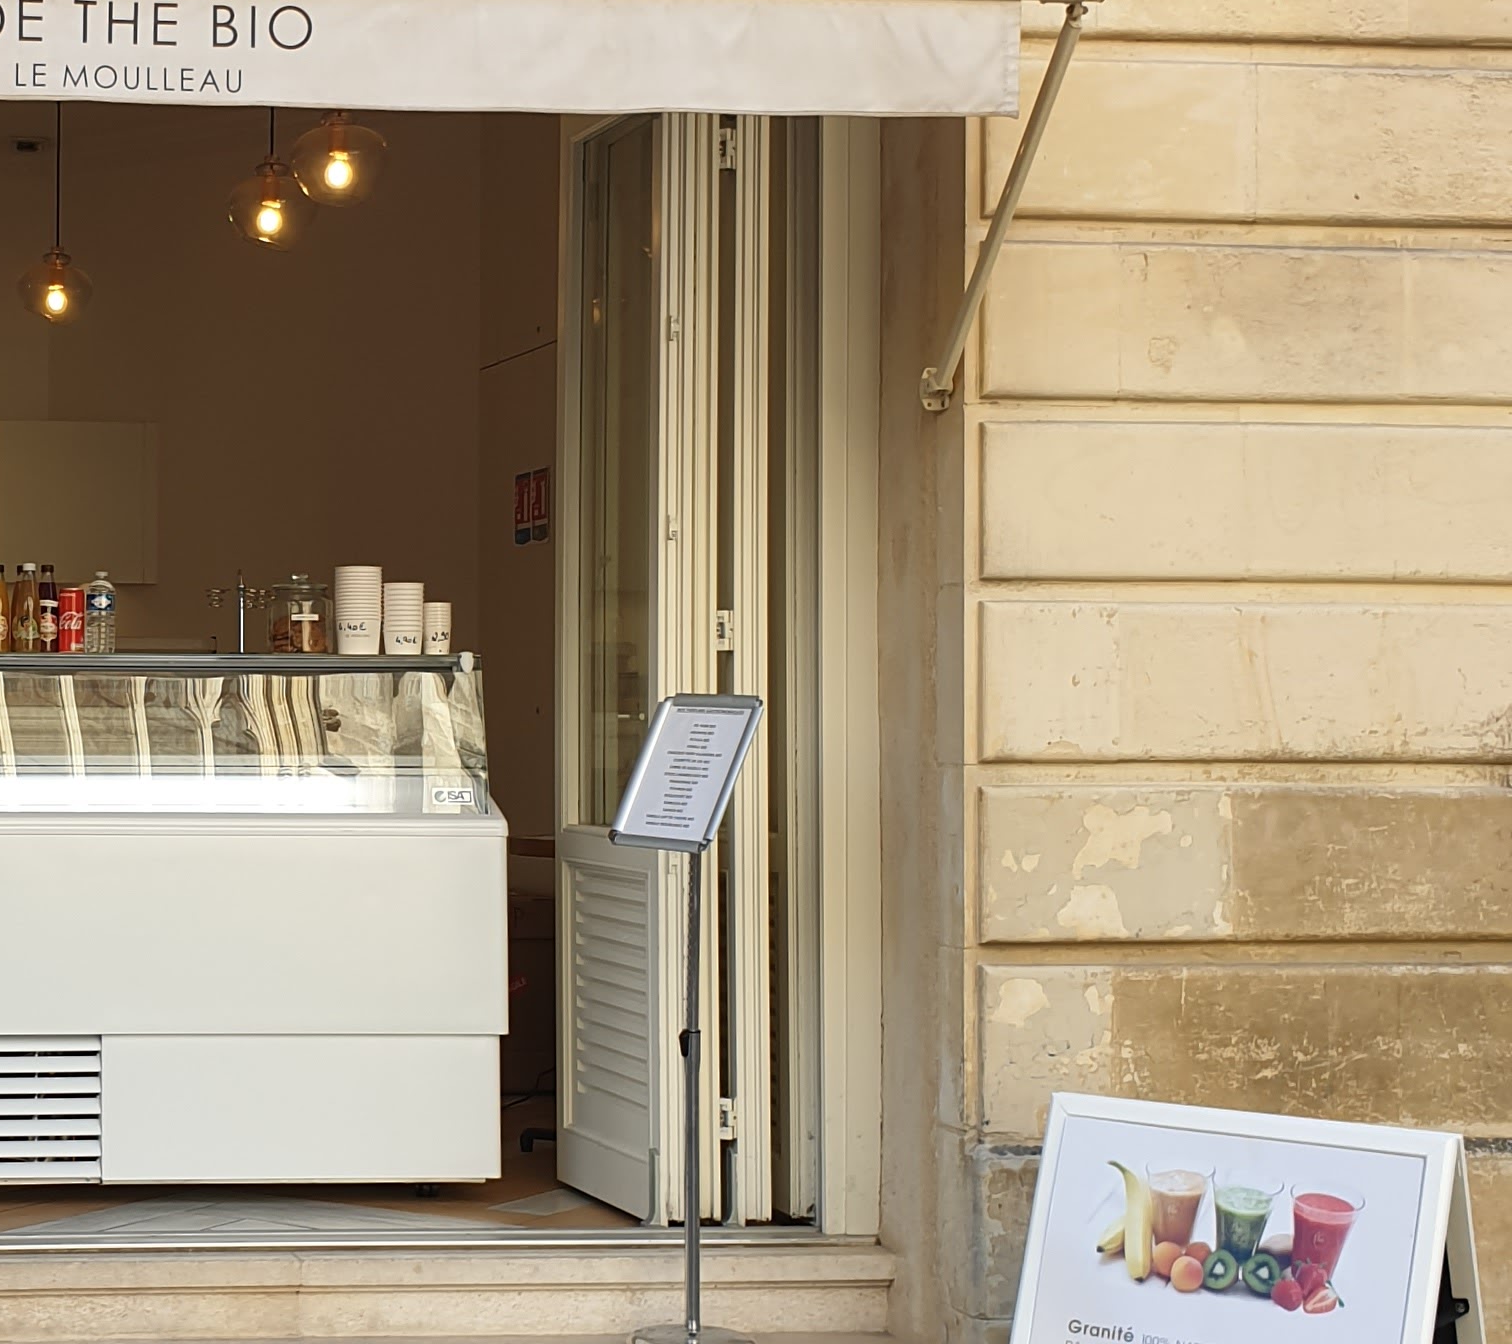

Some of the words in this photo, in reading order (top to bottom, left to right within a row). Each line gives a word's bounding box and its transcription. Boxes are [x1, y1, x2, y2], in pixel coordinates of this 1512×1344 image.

[73, 0, 179, 47] THE
[211, 4, 314, 51] BIO
[14, 62, 48, 88] LE
[62, 64, 244, 94] MOULLEAU
[1066, 1318, 1136, 1344] Granité
